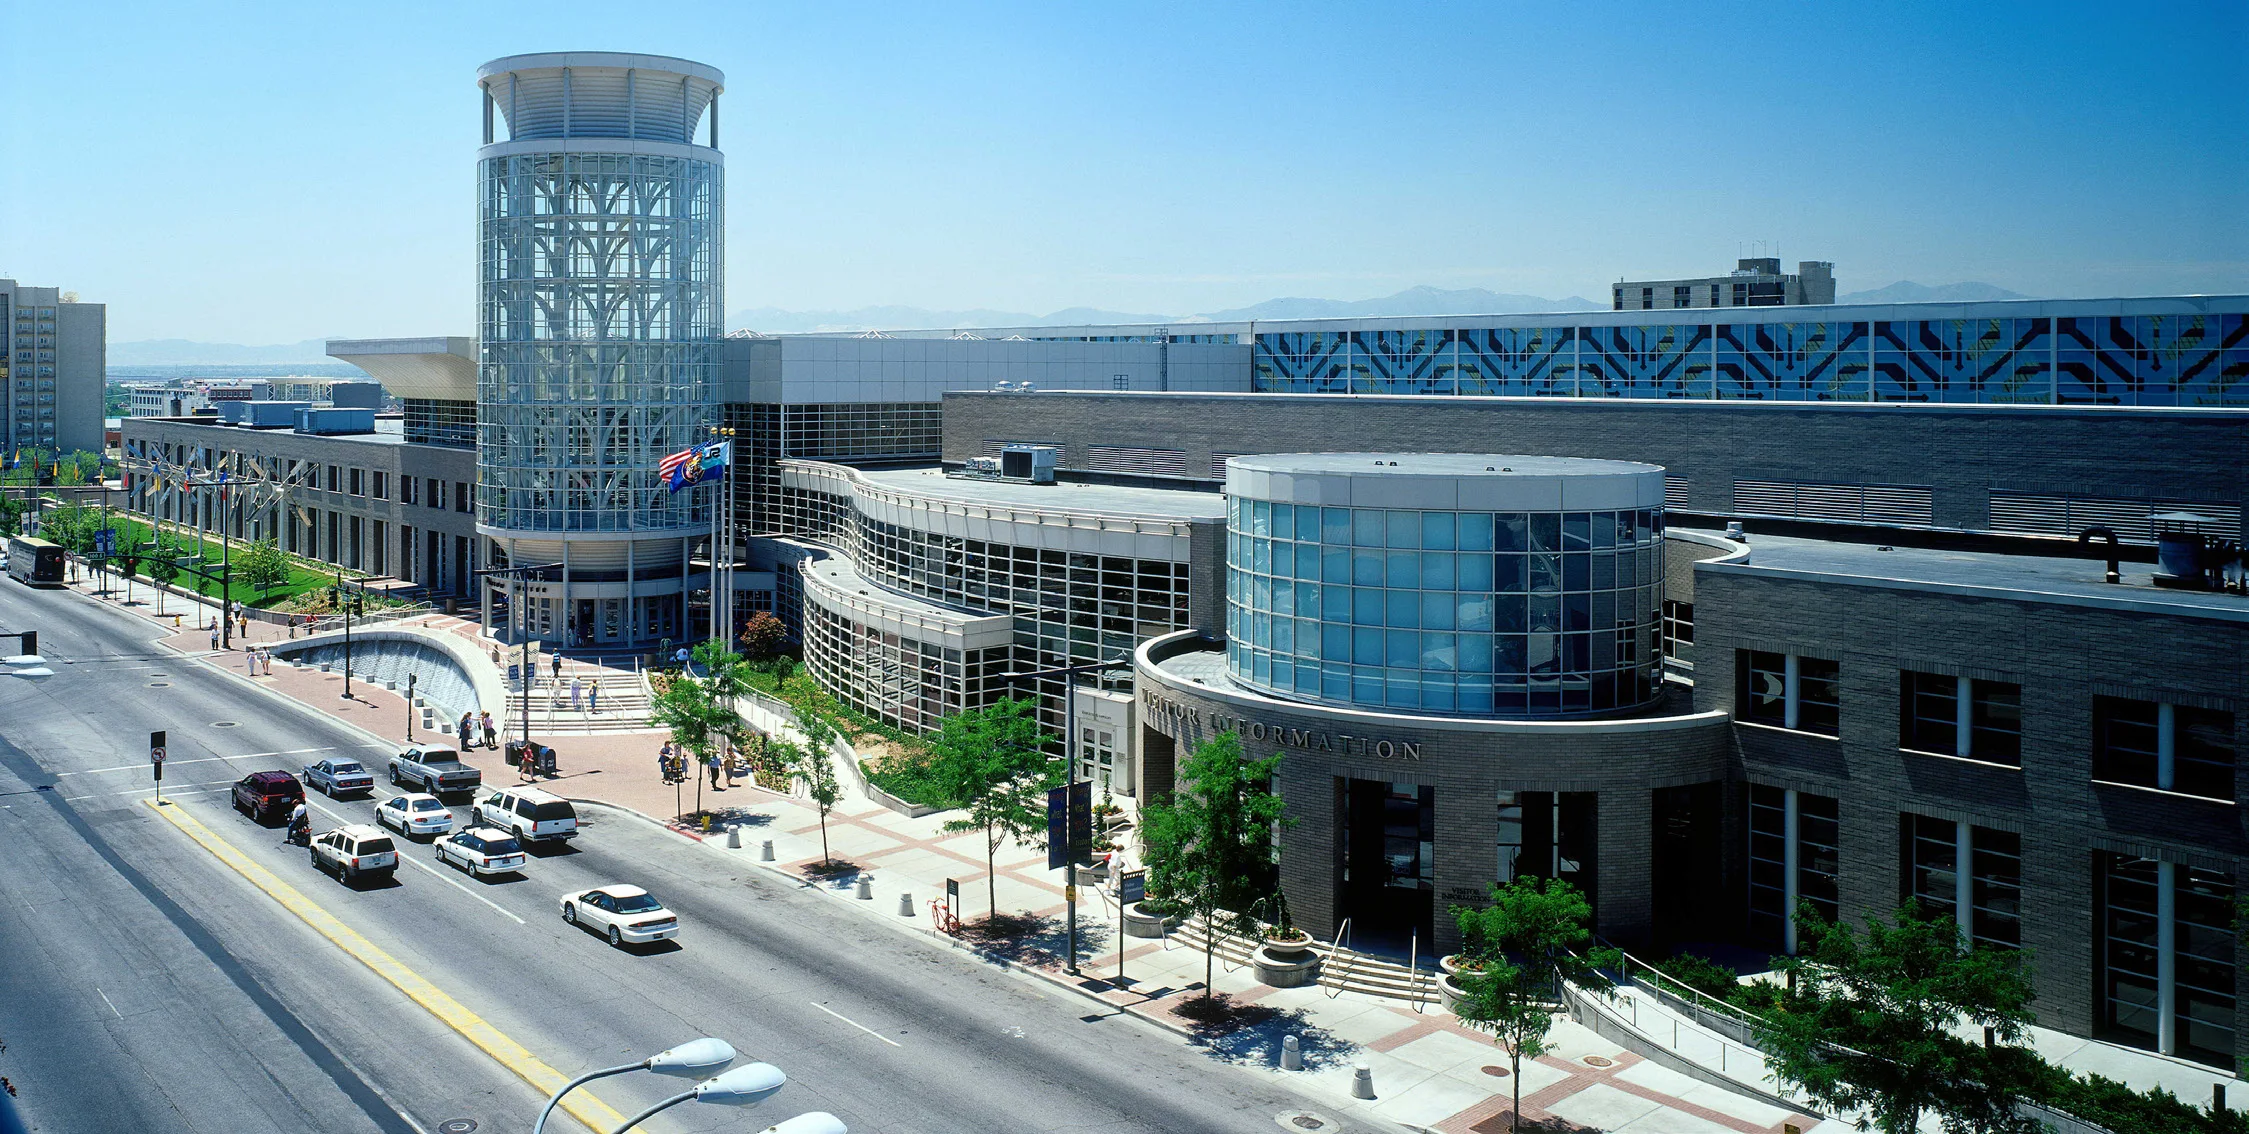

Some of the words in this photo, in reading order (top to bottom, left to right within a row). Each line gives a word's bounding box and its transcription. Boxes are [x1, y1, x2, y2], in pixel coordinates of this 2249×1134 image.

[1142, 686, 1199, 726] VISITOR
[1209, 711, 1422, 762] INFORMATION
[1451, 887, 1480, 896] VISITOR
[1442, 893, 1491, 902] INFORMATION
